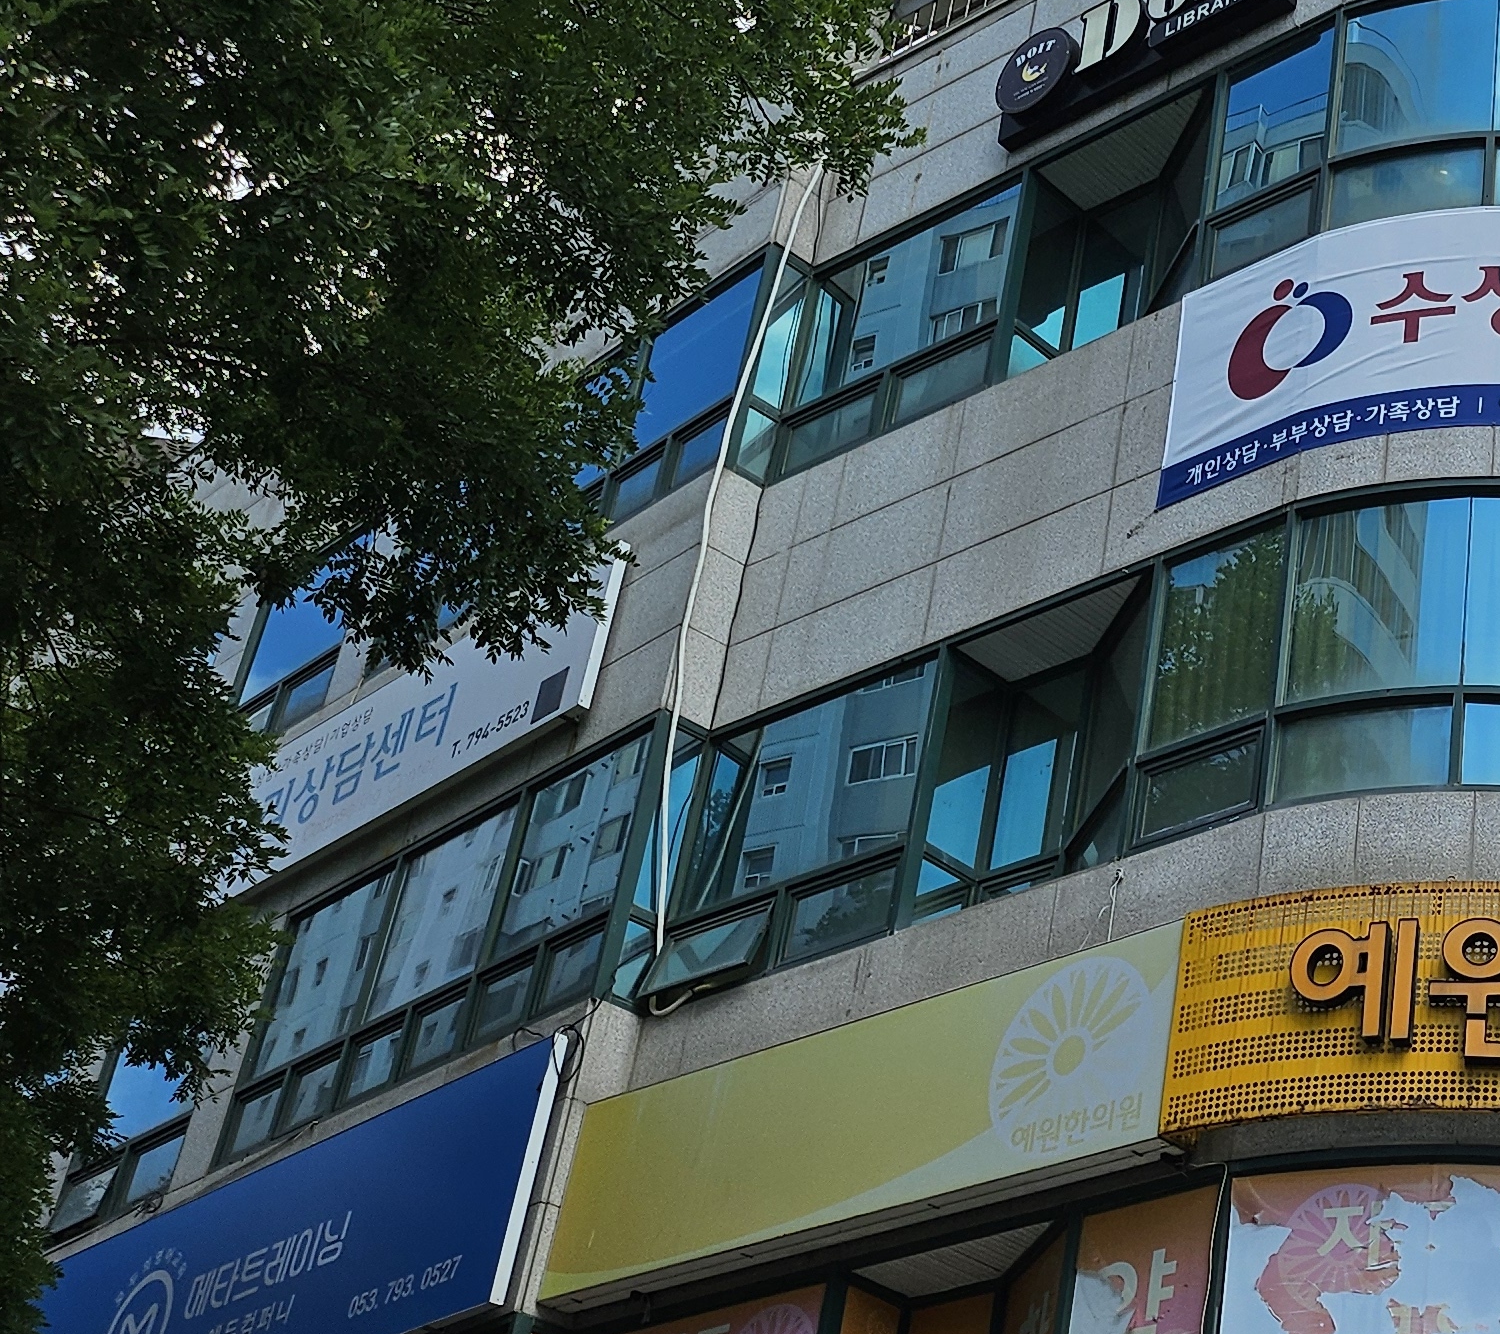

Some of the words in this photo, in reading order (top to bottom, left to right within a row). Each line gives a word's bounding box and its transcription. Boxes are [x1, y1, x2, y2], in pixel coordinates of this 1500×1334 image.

[1015, 38, 1057, 68] DOIT
[465, 701, 531, 751] 794-5523
[1011, 1092, 1143, 1154] 예원한의원
[184, 1210, 352, 1320] 메타트레이닝
[420, 1255, 463, 1291] 0527
